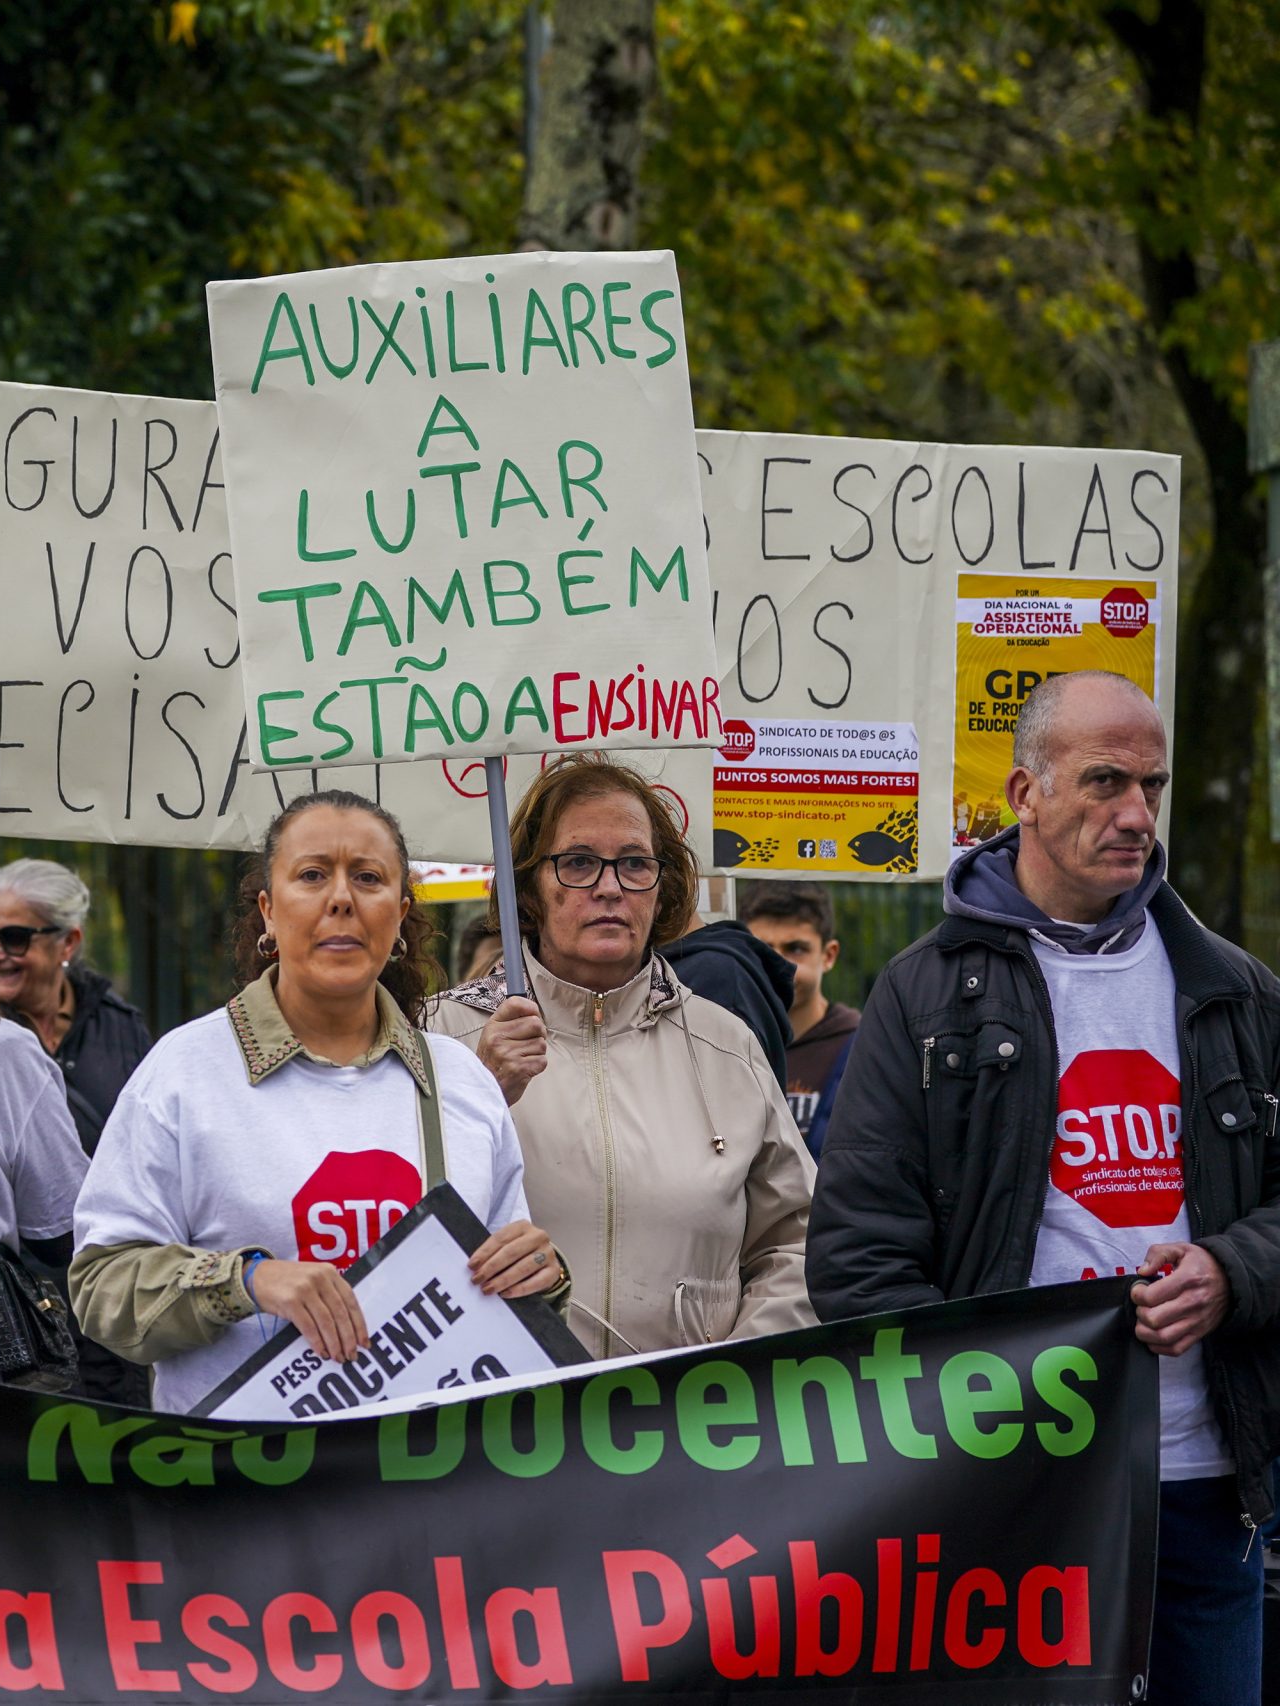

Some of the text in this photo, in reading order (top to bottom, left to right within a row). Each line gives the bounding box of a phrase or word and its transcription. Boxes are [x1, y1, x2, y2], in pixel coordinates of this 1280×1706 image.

[417, 394, 480, 457] A
[297, 440, 608, 563] LUTAR
[762, 458, 1169, 571] ESCOLAS
[258, 518, 690, 662] TAMBÉM
[1016, 589, 1029, 597] POR
[984, 601, 1003, 609] DIA
[1005, 601, 1061, 610] NACIONAL
[983, 612, 1072, 623] ASSISTENTE
[974, 623, 1082, 634] OPERACIONAL
[713, 591, 855, 709] OS
[1006, 637, 1050, 648] DA EDUCAÇÃO
[257, 647, 490, 766] ESTÃO
[504, 676, 549, 735] A
[969, 702, 986, 716] DE
[759, 727, 896, 741] SINDICATO DE TOD@S @S
[759, 747, 839, 759] PROFISSIONAIS
[841, 749, 857, 759] DA
[860, 748, 918, 762] EDUCAÇÃO
[716, 771, 916, 787] JUNTOS SOMOS MAIS FORTES!
[714, 797, 765, 805] CONTACTOS
[797, 799, 860, 809] INFORMAÇÕES
[713, 810, 847, 821] www.stop-sindicato.pt
[1082, 1166, 1127, 1182] sindicato
[1128, 1166, 1141, 1178] de
[1074, 1181, 1137, 1200] profissionais
[1138, 1179, 1152, 1191] de
[270, 1349, 331, 1398] PESS
[97, 1556, 574, 1693] Escola
[602, 1533, 1092, 1683] Pública
